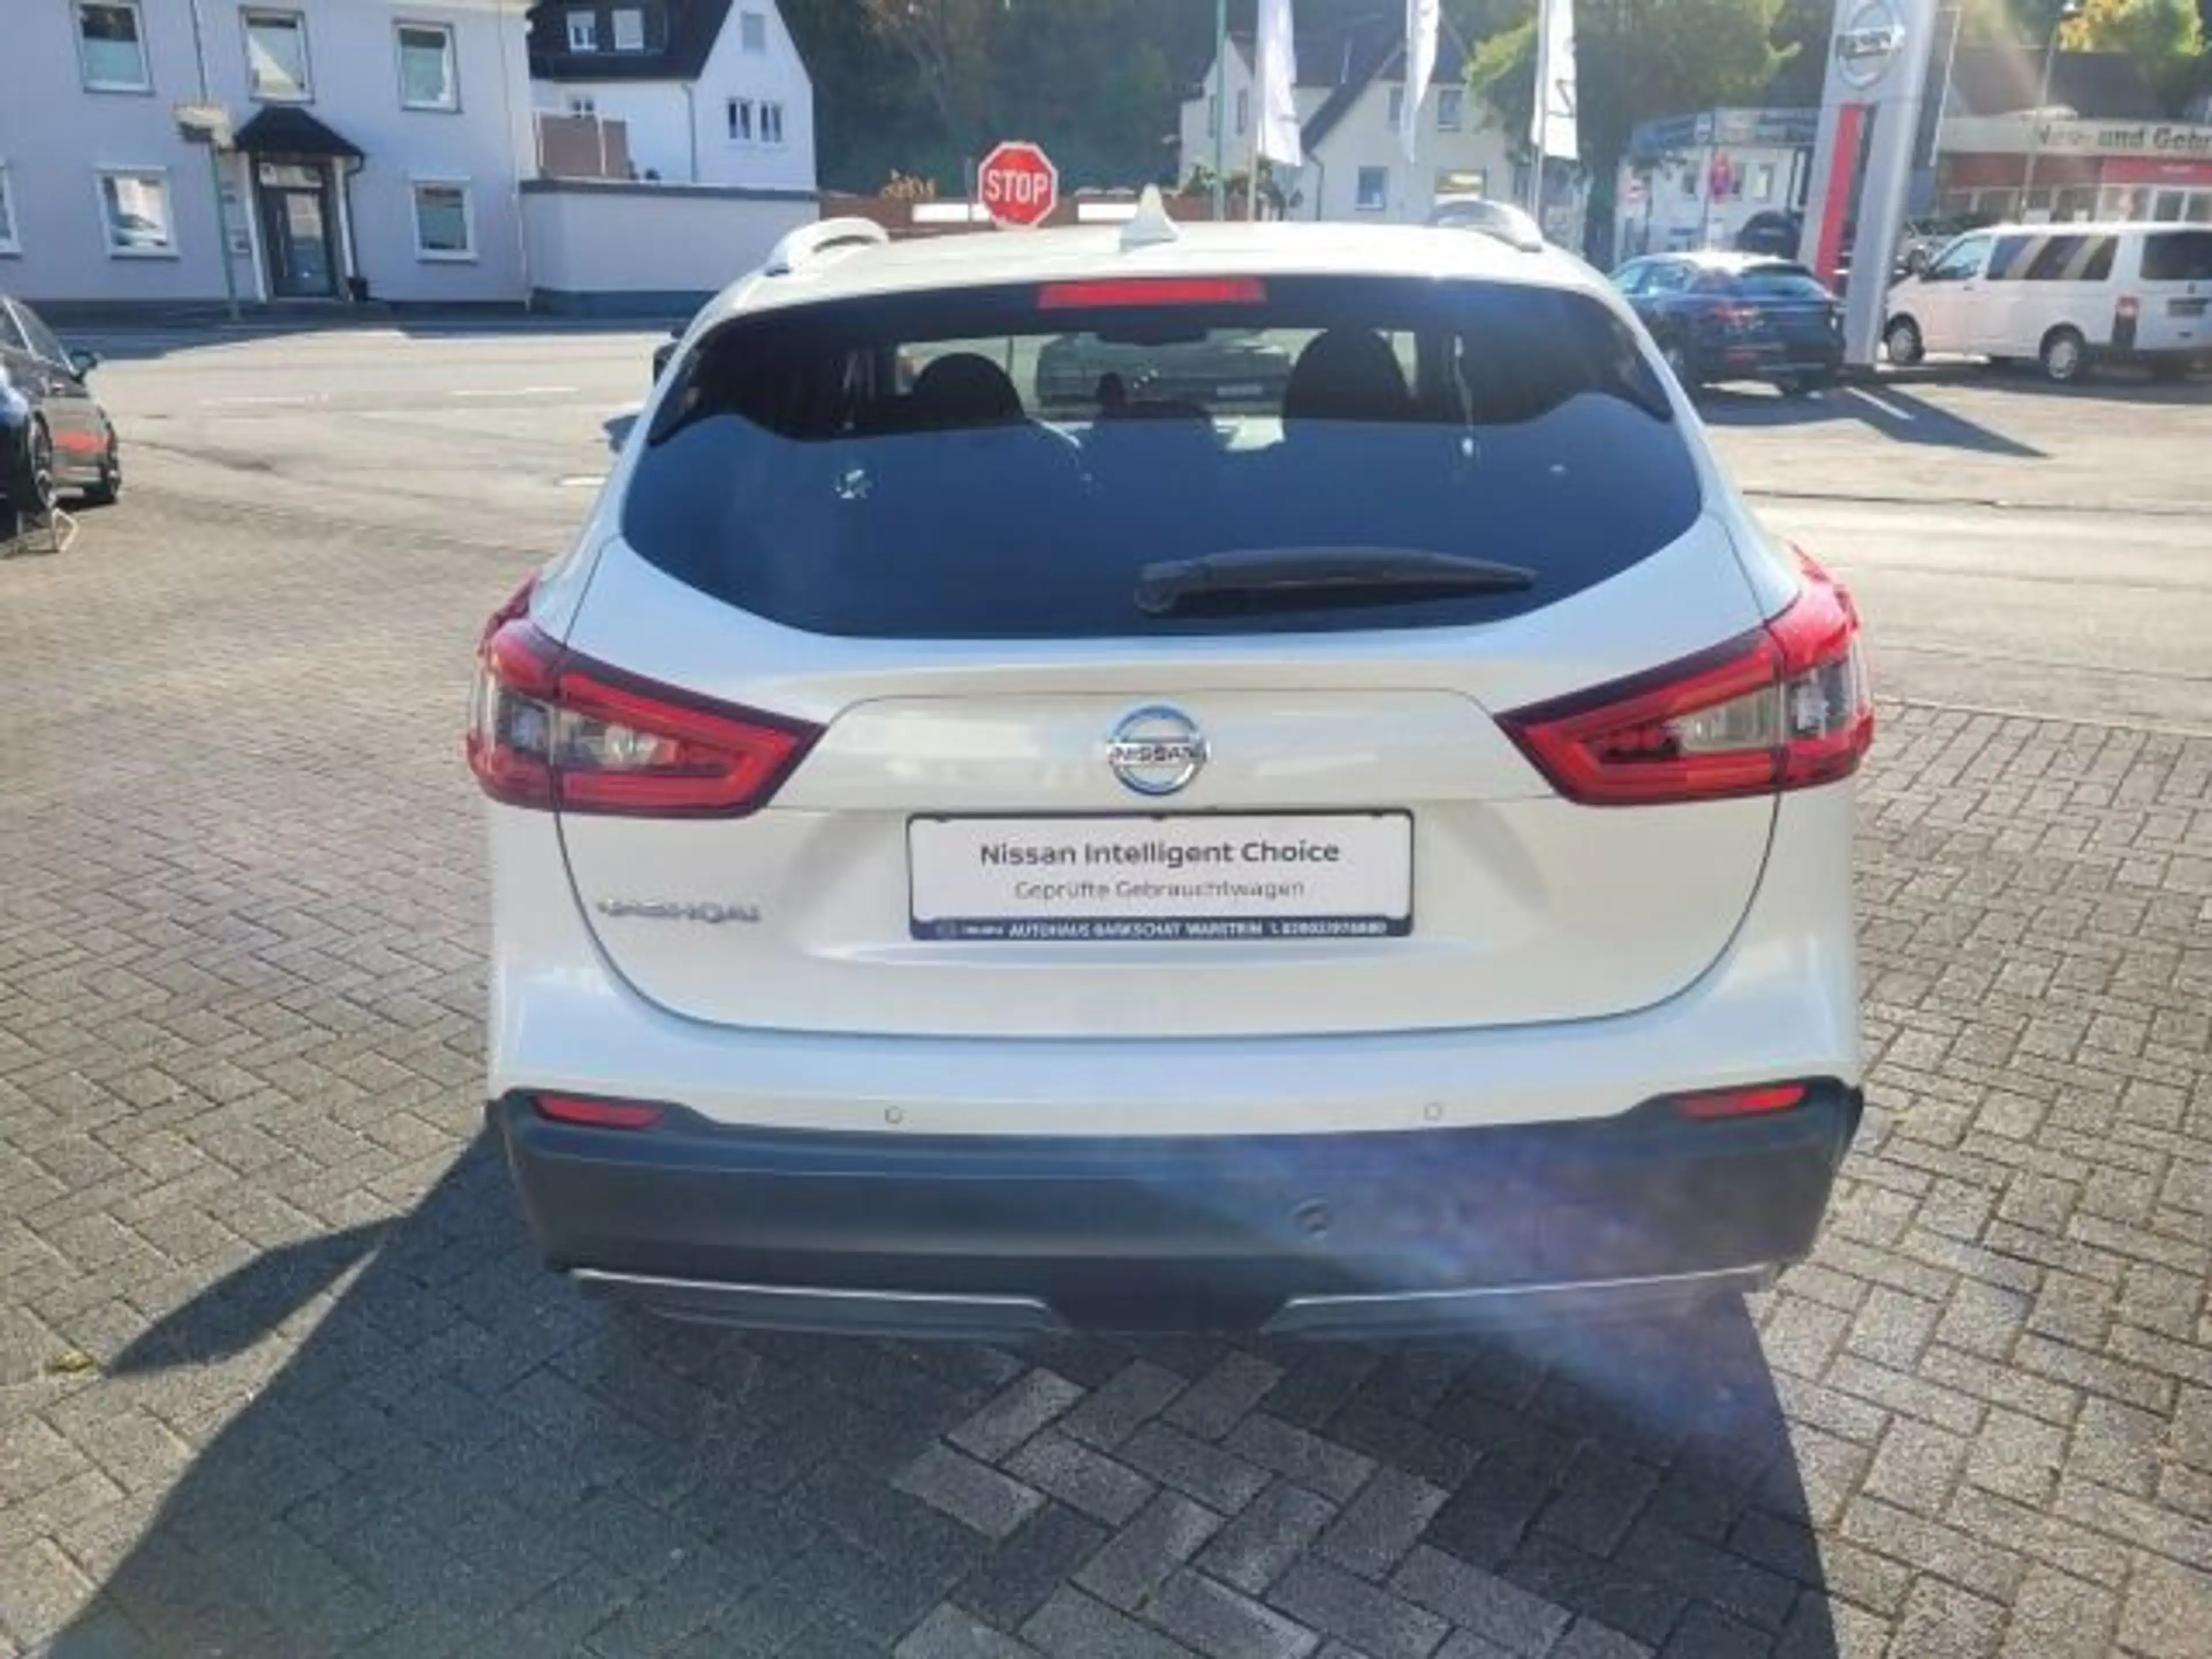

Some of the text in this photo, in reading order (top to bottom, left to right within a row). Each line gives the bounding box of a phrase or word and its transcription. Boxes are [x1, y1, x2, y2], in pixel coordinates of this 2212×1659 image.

[2099, 126, 2145, 147] und
[984, 168, 1049, 206] STOP
[980, 839, 1339, 868] Nissan Intelligent Choice
[1015, 879, 1305, 903] Geprüfte Gebrauchtwagen
